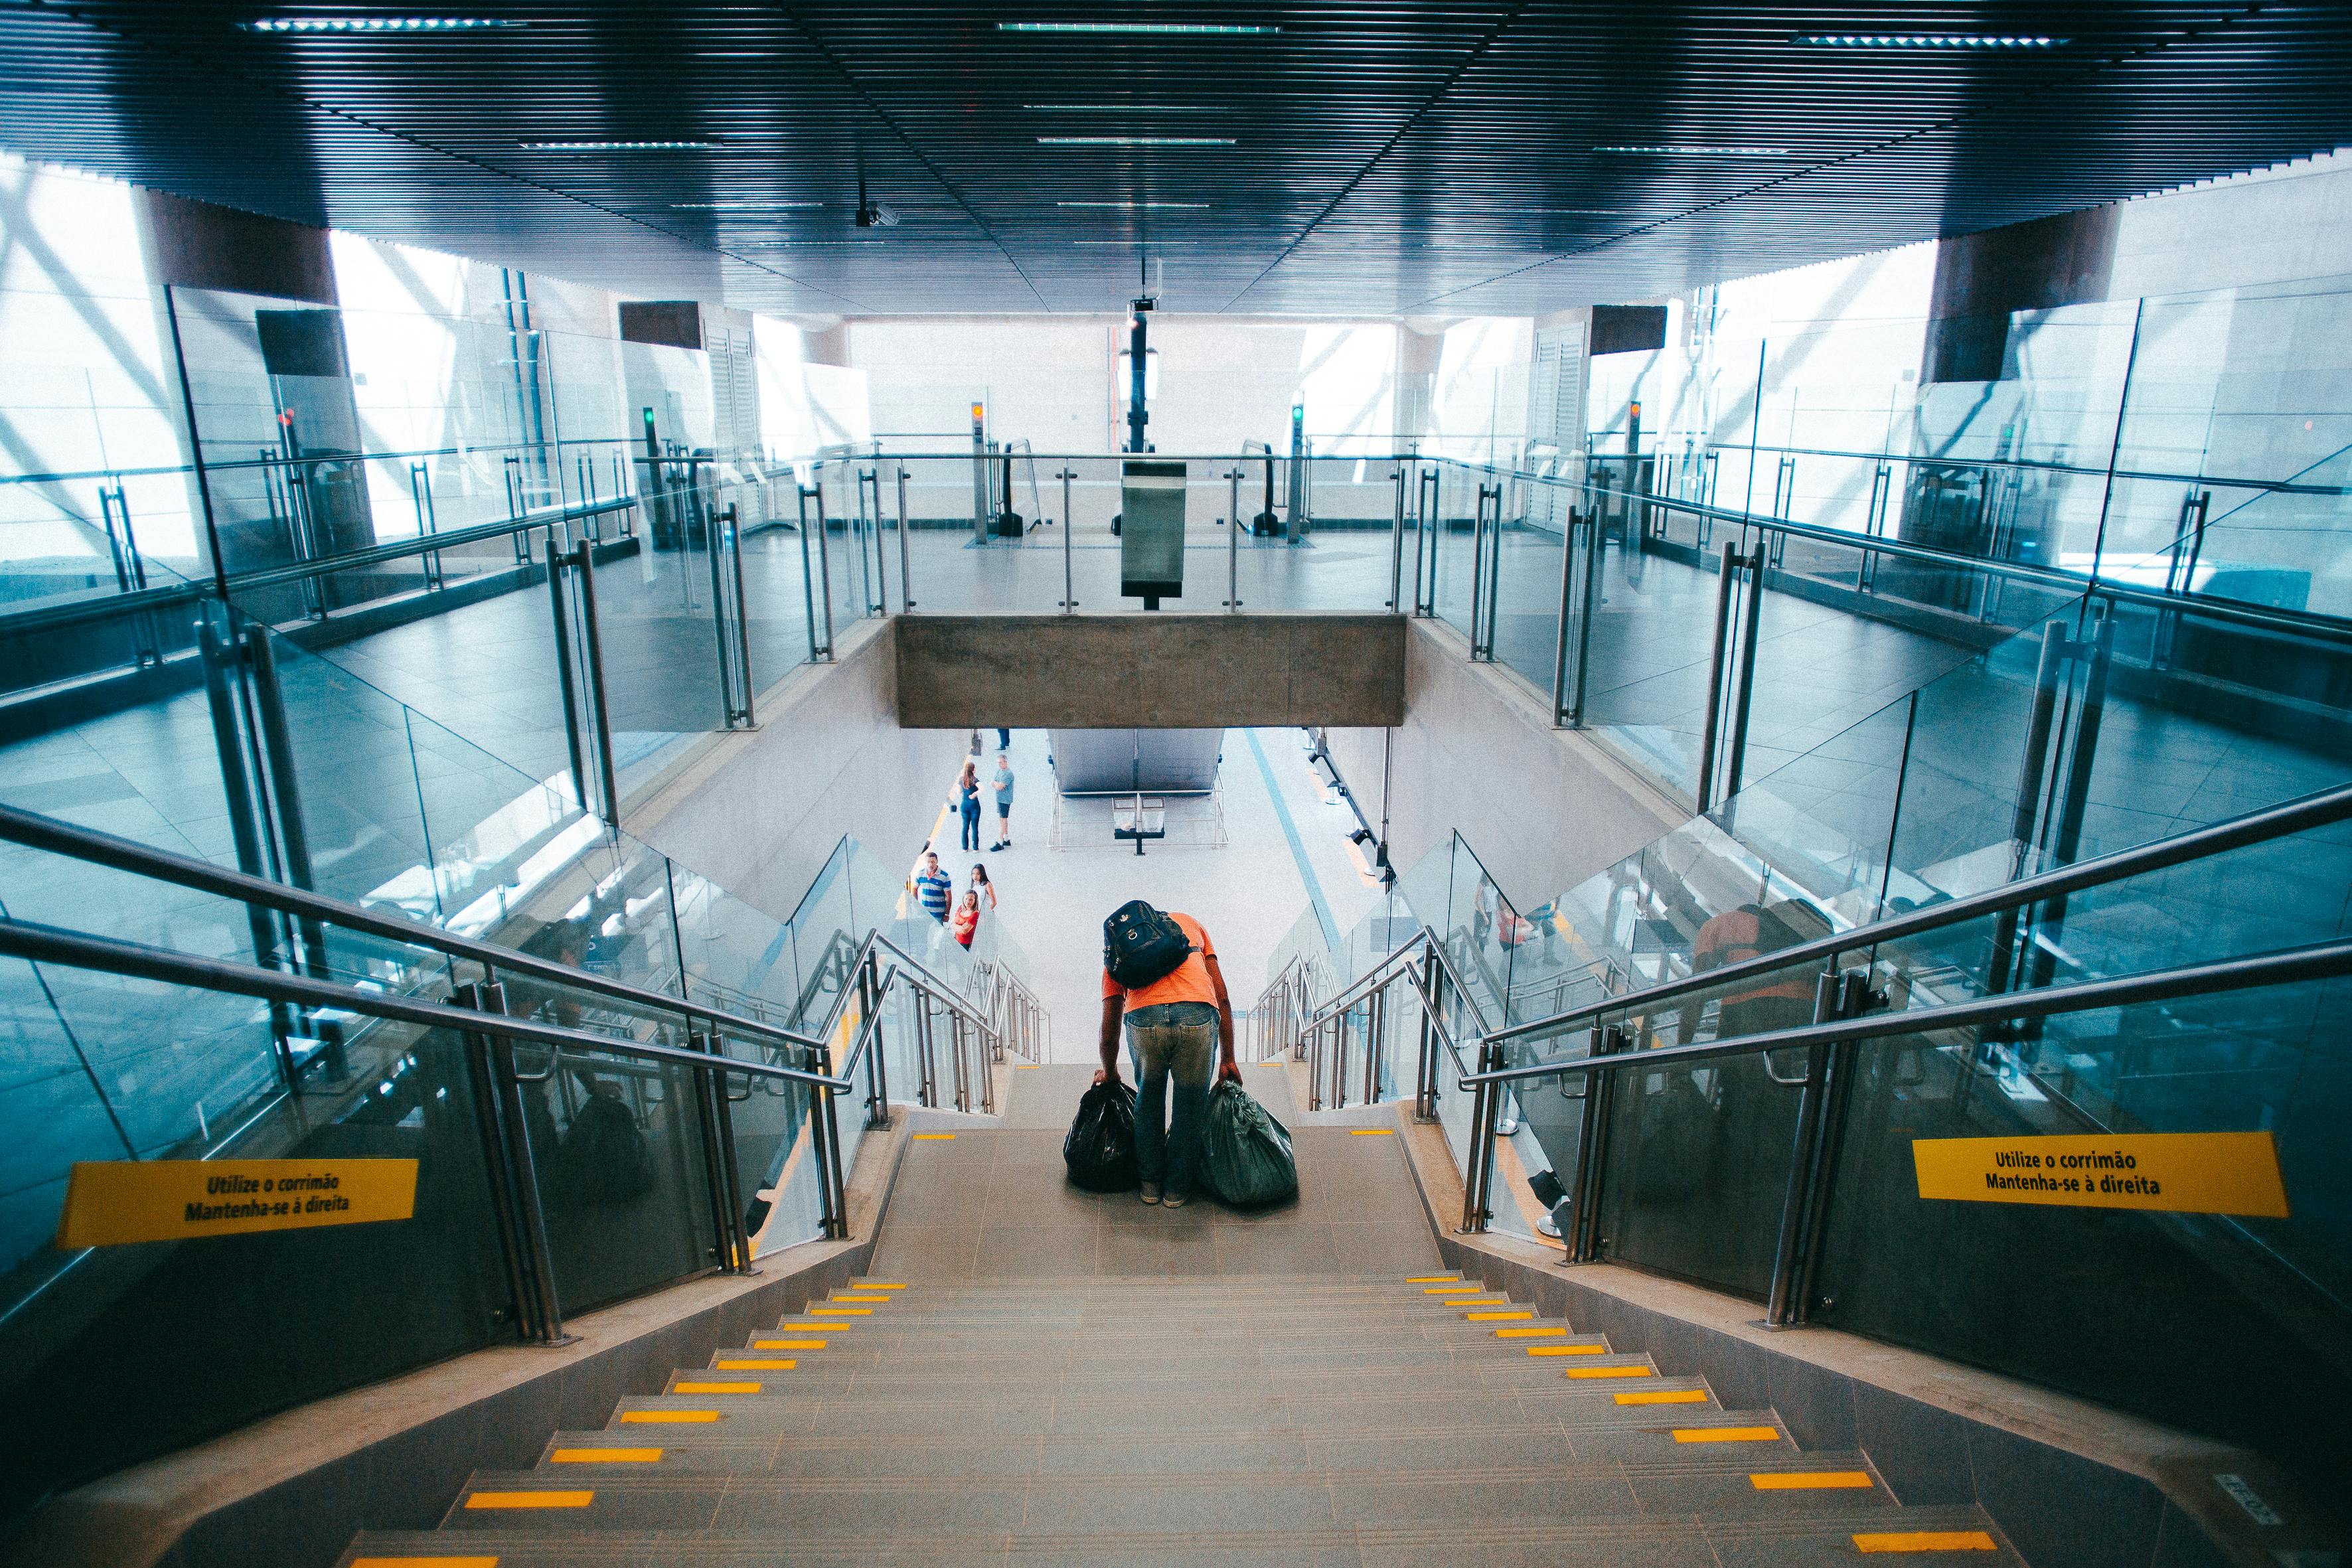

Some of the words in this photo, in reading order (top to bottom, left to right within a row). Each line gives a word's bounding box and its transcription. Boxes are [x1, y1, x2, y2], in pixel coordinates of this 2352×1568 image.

[1995, 1150, 2041, 1168] Utilize
[2045, 1155, 2056, 1168] o
[2059, 1150, 2136, 1169] corrimão
[207, 1174, 260, 1194] Utilize
[263, 1178, 274, 1192] o
[277, 1173, 339, 1192] corrimão
[1985, 1173, 2080, 1192] Mantenha-se
[2084, 1174, 2095, 1193] à
[2100, 1174, 2161, 1195] direita
[185, 1198, 289, 1221] Mantenha-se
[292, 1196, 302, 1214] à
[305, 1195, 350, 1214] direita
